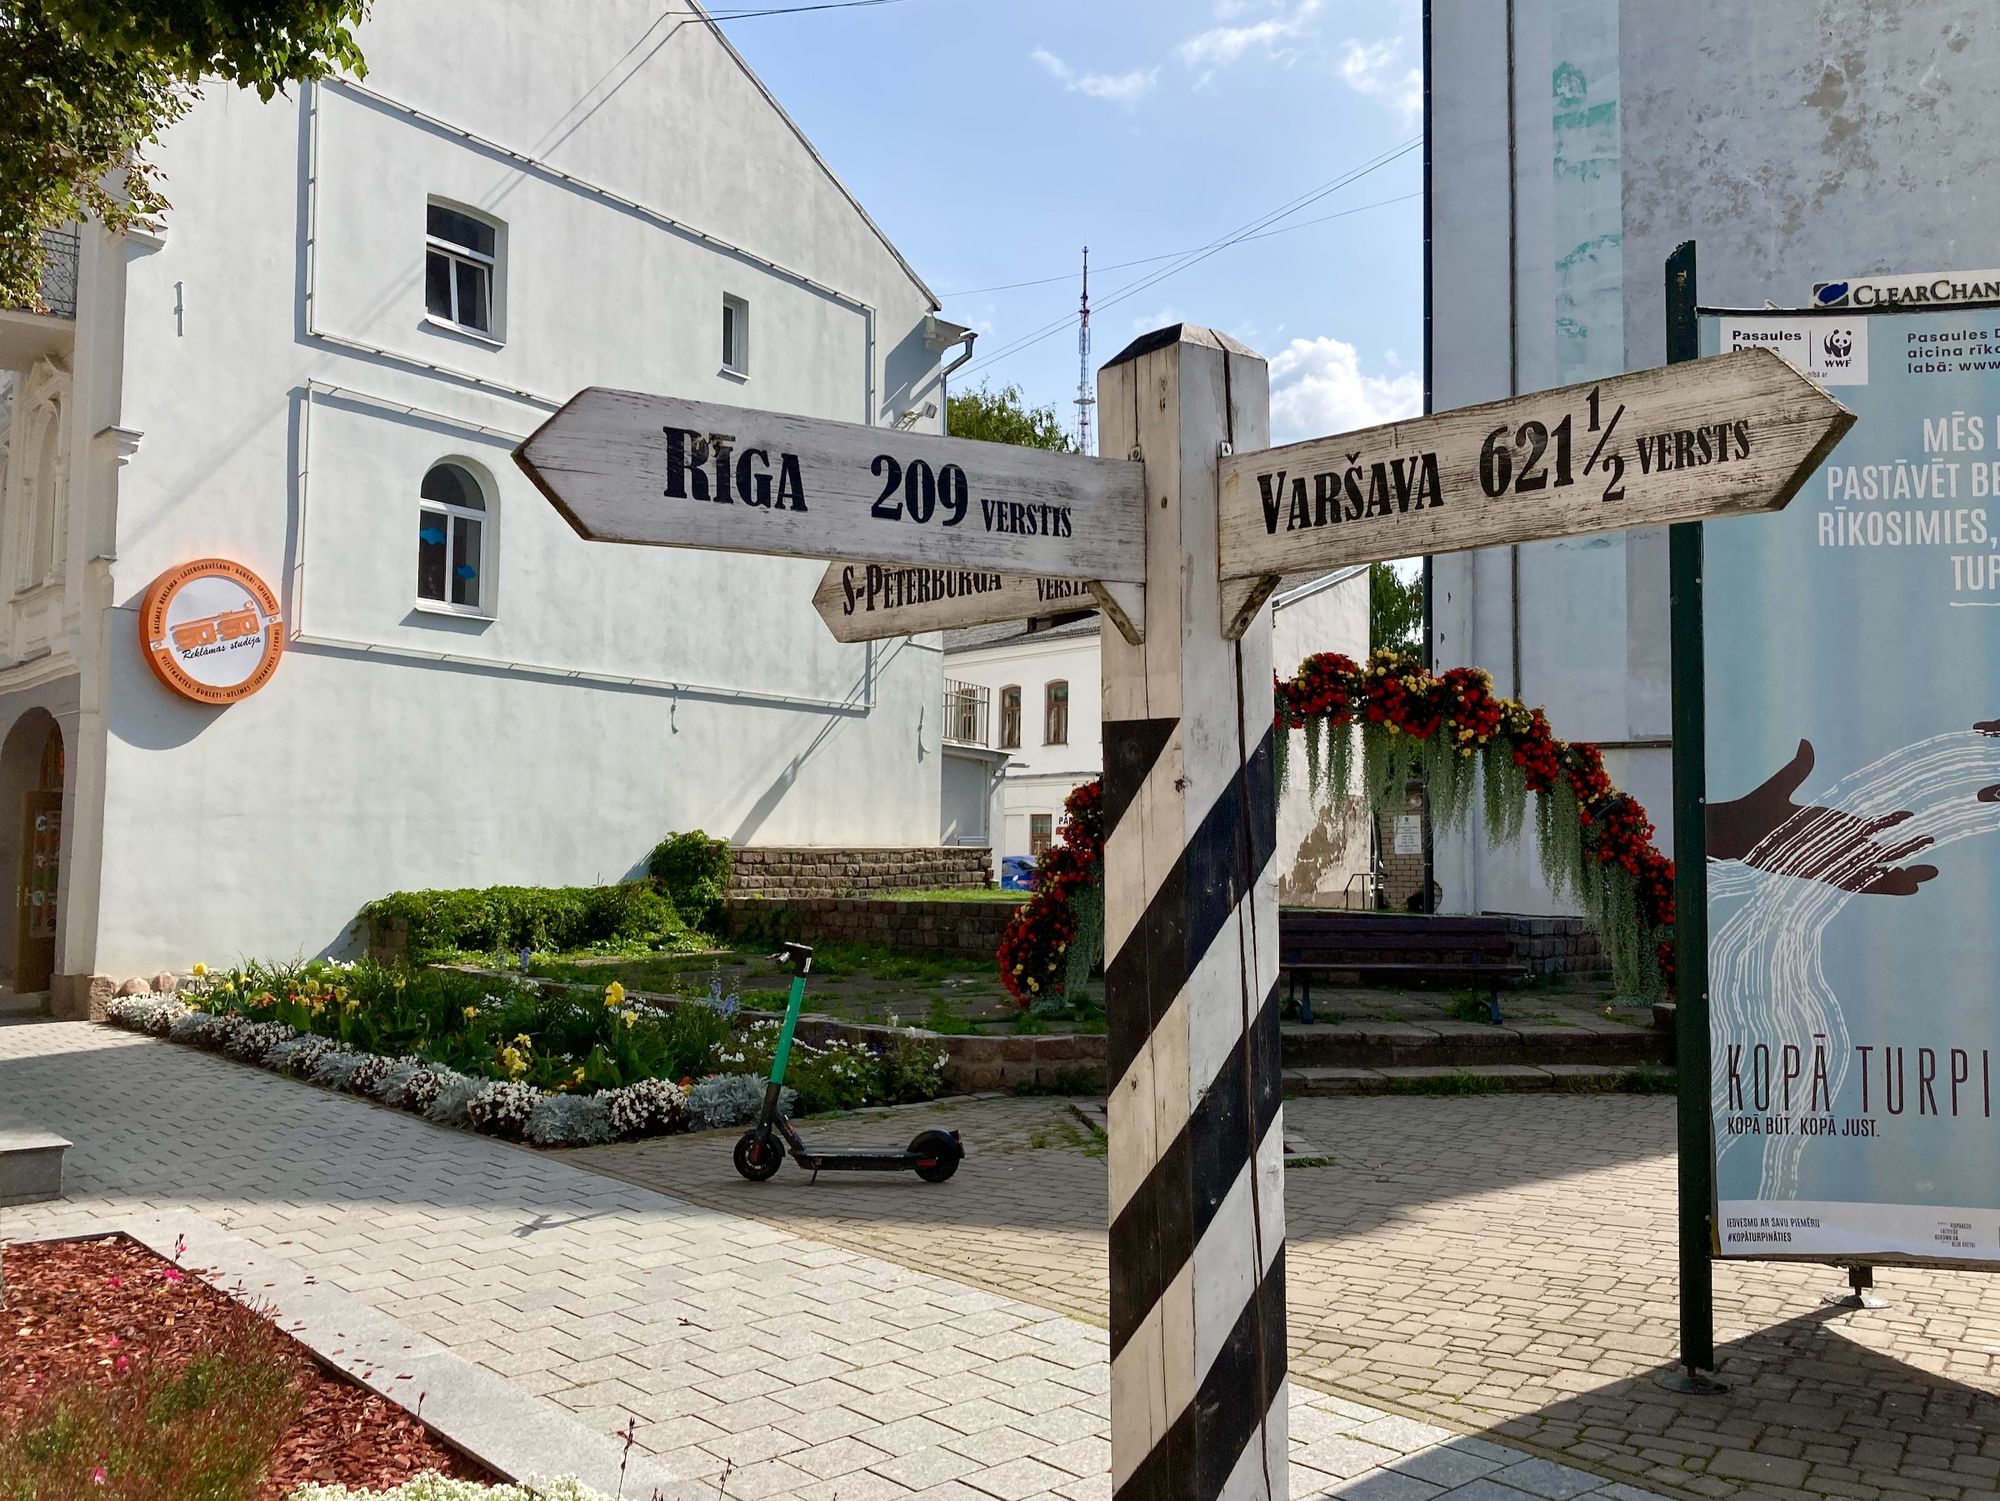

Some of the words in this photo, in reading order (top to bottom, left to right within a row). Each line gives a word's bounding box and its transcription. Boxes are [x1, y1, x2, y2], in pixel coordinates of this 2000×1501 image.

[1732, 330, 1802, 341] Pasaules
[1907, 330, 1987, 343] Pasaules
[1825, 360, 1851, 368] WWF
[1908, 346, 1963, 359] aicina
[1908, 361, 1952, 374] labā:
[1923, 411, 1984, 452] MĒS
[663, 426, 808, 512] RĪGA
[870, 453, 969, 527] 209
[1257, 450, 1445, 534] VARŠAVA
[1635, 418, 1751, 475] VERSTS
[1827, 458, 1960, 500] PASTĀVĒT
[1818, 506, 1998, 549] RĪKOSIMIES,
[182, 644, 227, 660] Reklāmas
[230, 636, 262, 649] studija
[1727, 1034, 1830, 1111] KOPĀ
[1855, 1046, 1990, 1117] TURPI
[1727, 1113, 1760, 1135] KOPĀ
[1766, 1113, 1794, 1136] BŪT.
[1800, 1114, 1837, 1136] KOPĀ
[1842, 1118, 1880, 1137] JUST.
[1727, 1217, 1758, 1228] IEDVESMO
[1760, 1217, 1769, 1228] AR
[1771, 1217, 1789, 1228] SAVU
[1727, 1230, 1792, 1242] #KOPĀTURPINĀTIES
